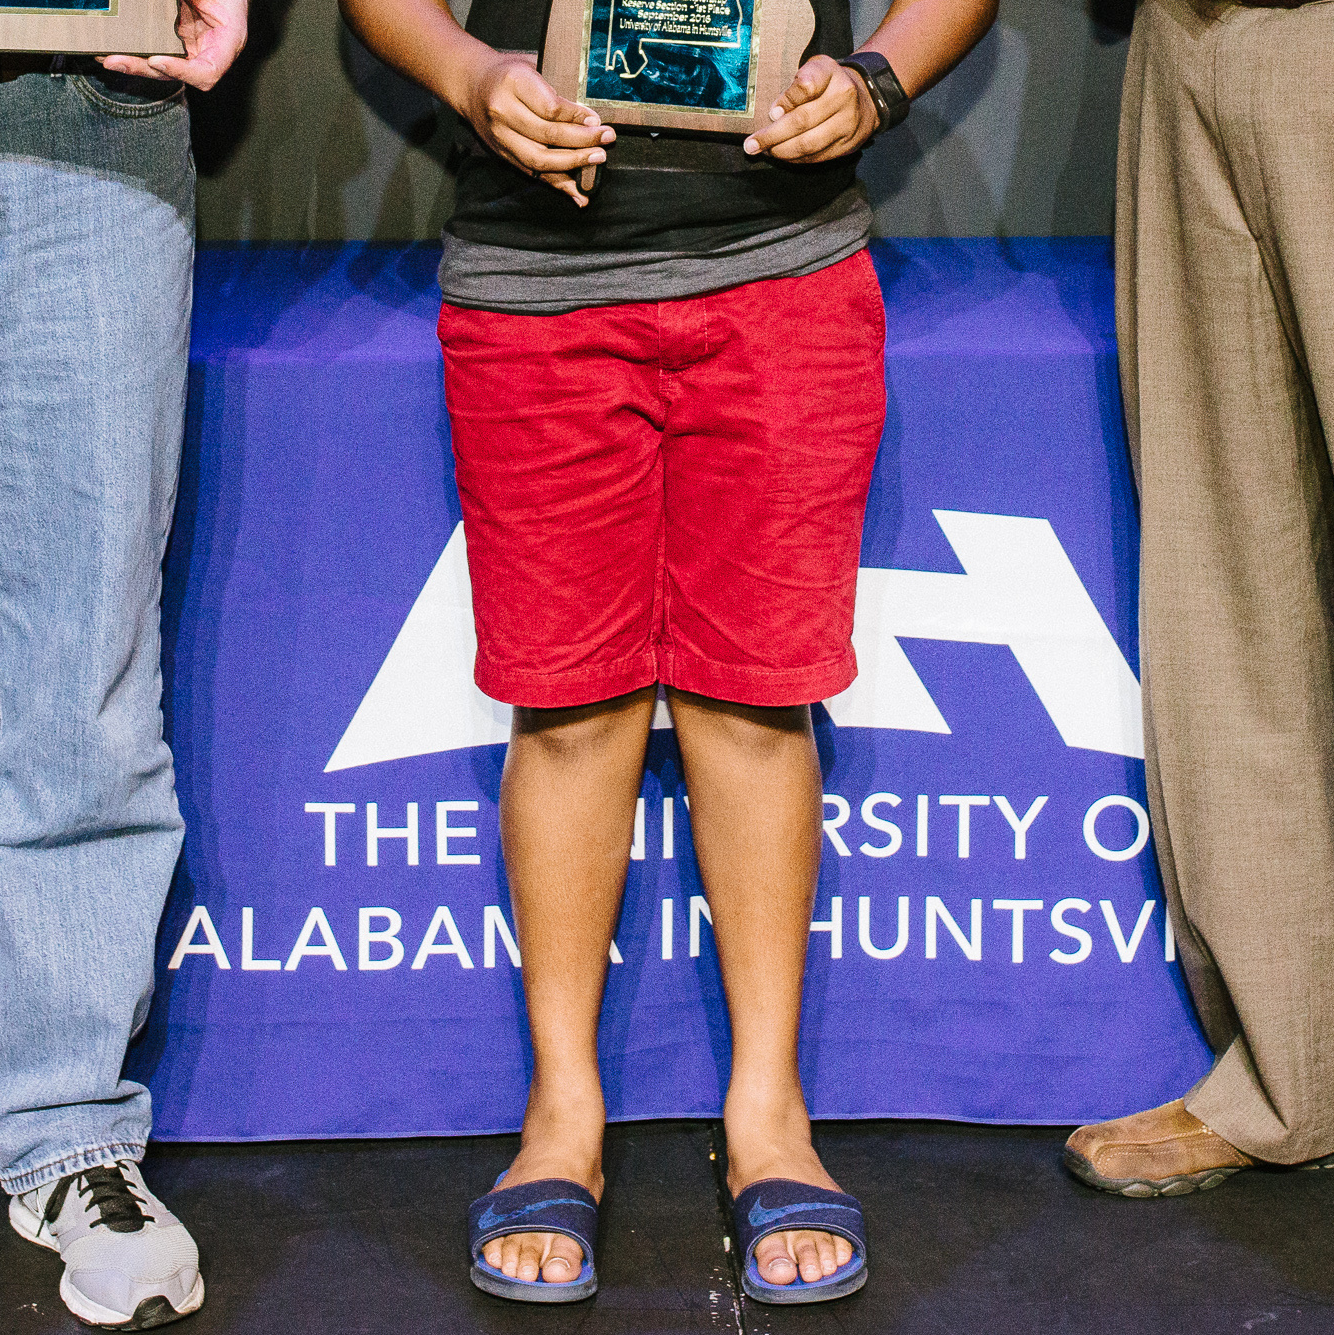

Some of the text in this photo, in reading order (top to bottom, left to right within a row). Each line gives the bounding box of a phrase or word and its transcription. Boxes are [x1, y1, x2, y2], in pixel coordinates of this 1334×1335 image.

[655, 0, 688, 11] Section
[695, 3, 707, 13] 1st
[707, 4, 731, 15] Place
[637, 9, 712, 24] September 2016
[619, 18, 733, 37] University of Alabama in Huntsville
[304, 800, 481, 866] THE
[1082, 795, 1150, 861] O
